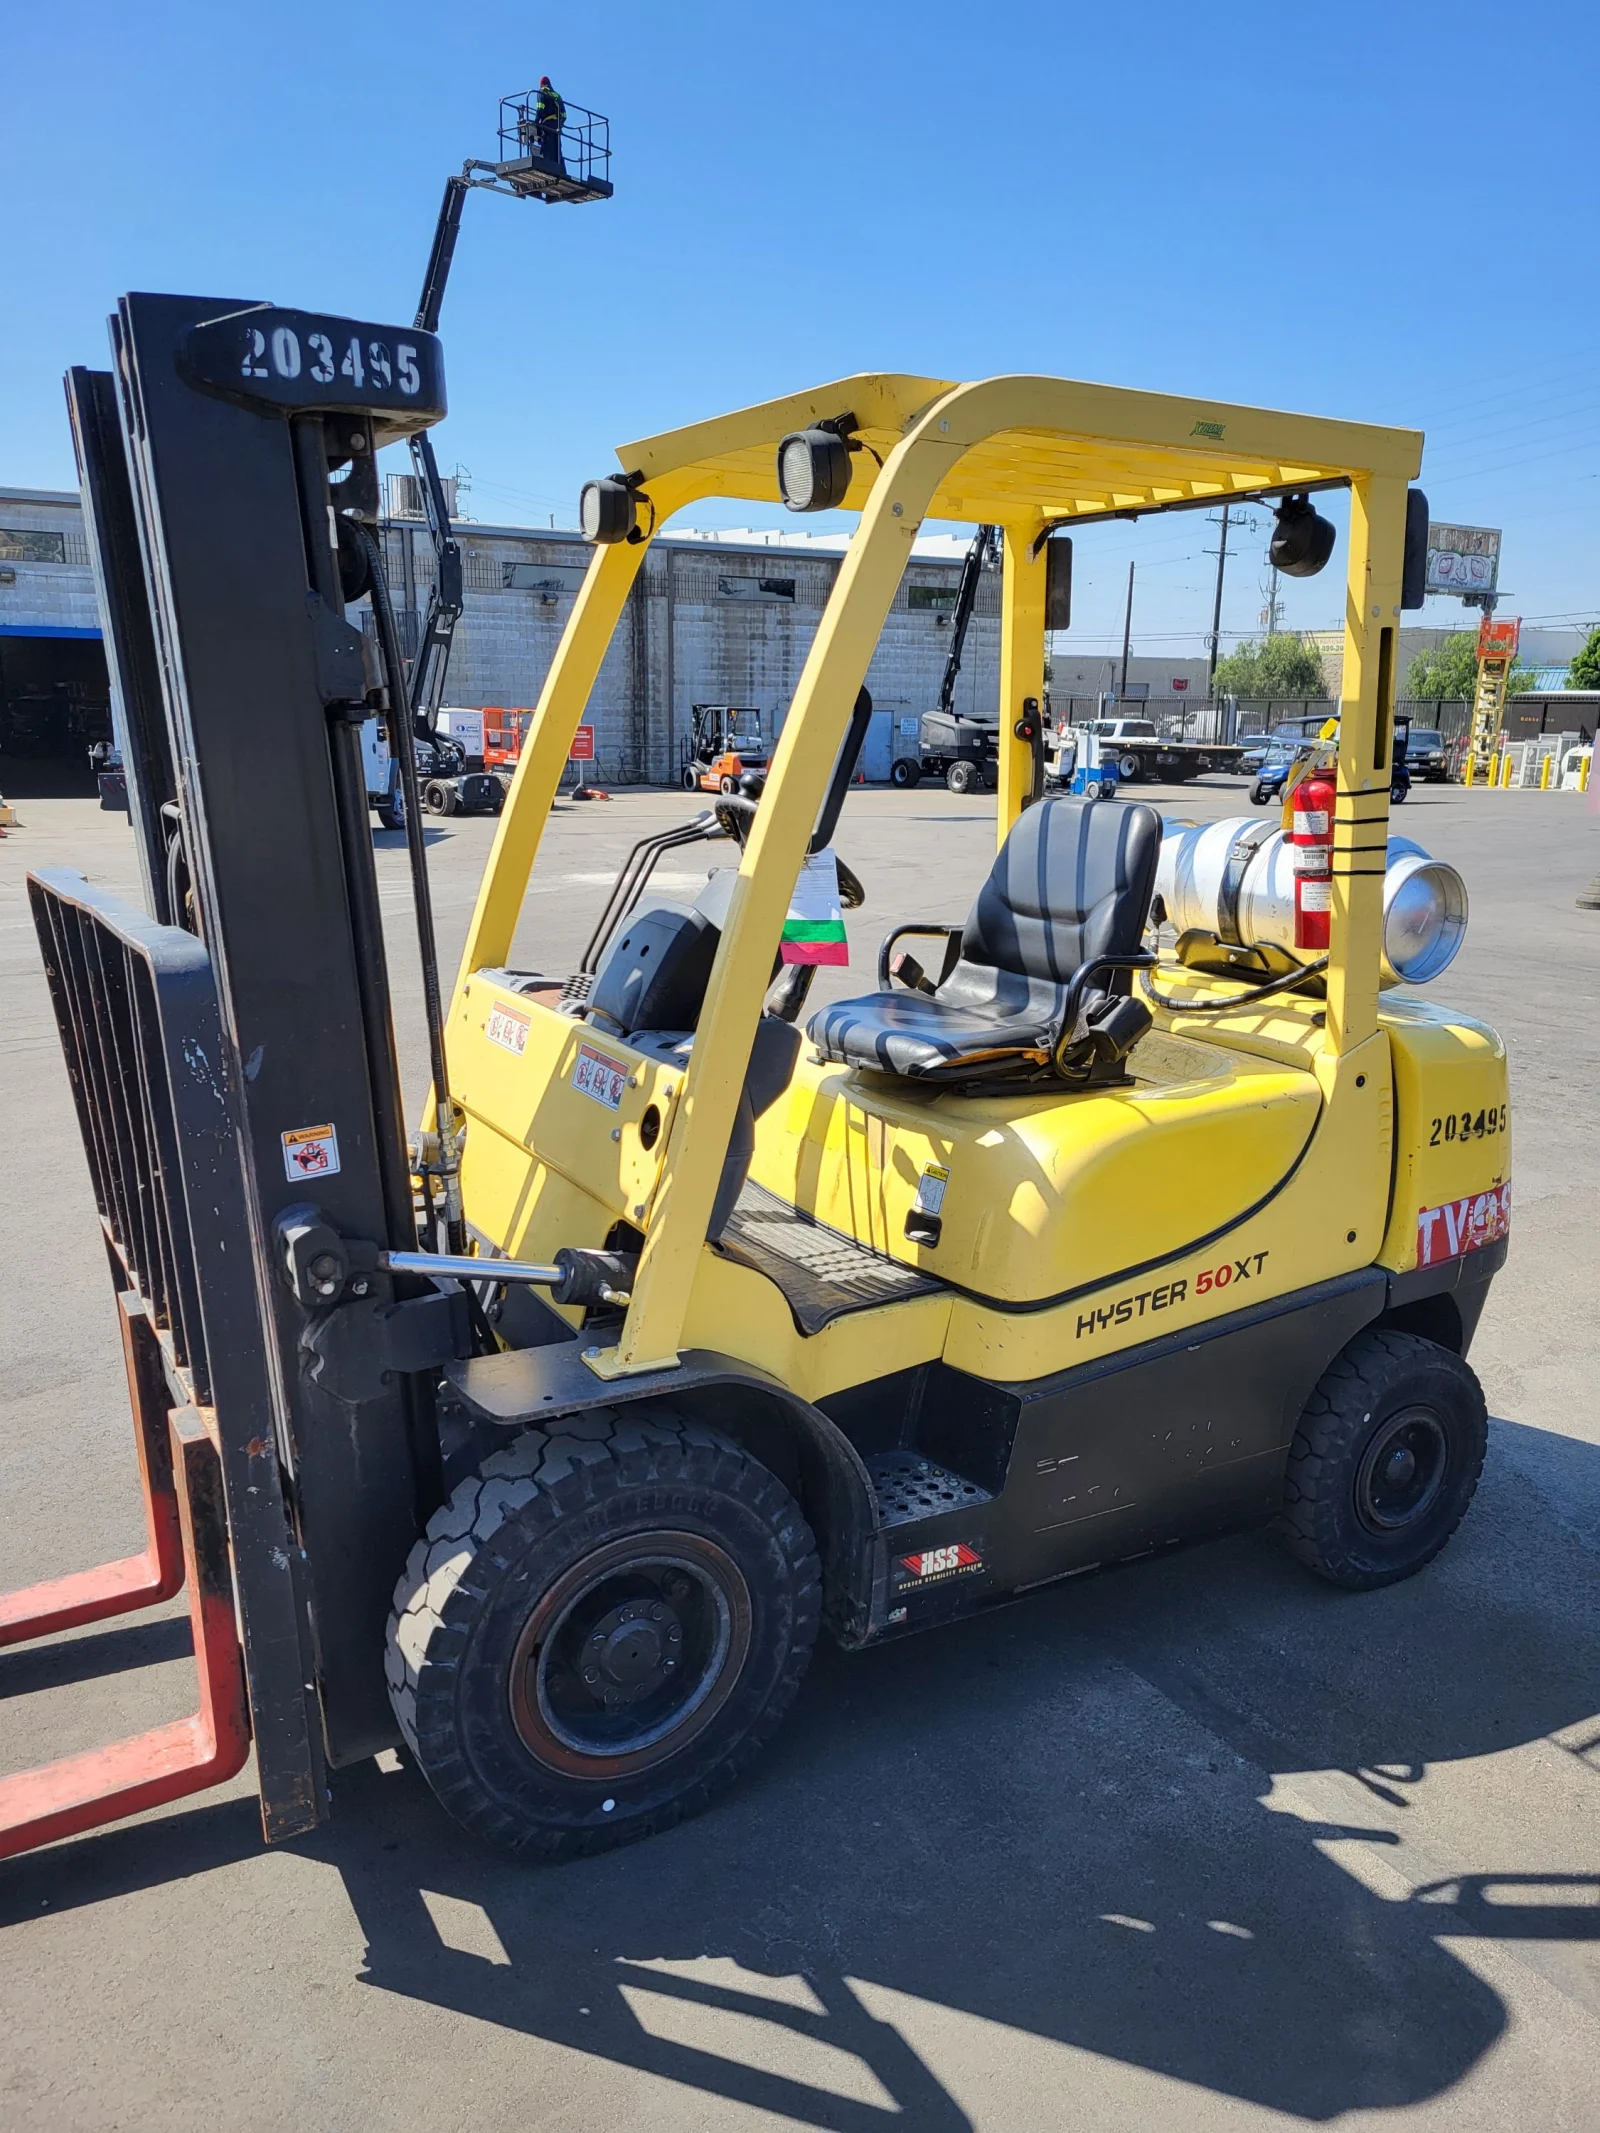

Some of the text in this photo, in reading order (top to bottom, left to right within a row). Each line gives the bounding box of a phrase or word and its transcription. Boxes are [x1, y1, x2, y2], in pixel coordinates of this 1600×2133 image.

[240, 326, 421, 395] 203495
[298, 1129, 330, 1140] WARNING
[1429, 1103, 1506, 1147] 203495
[1076, 1251, 1269, 1339] HYSTER 50XT
[920, 1545, 959, 1577] HSS
[925, 1569, 957, 1583] STABILITY
